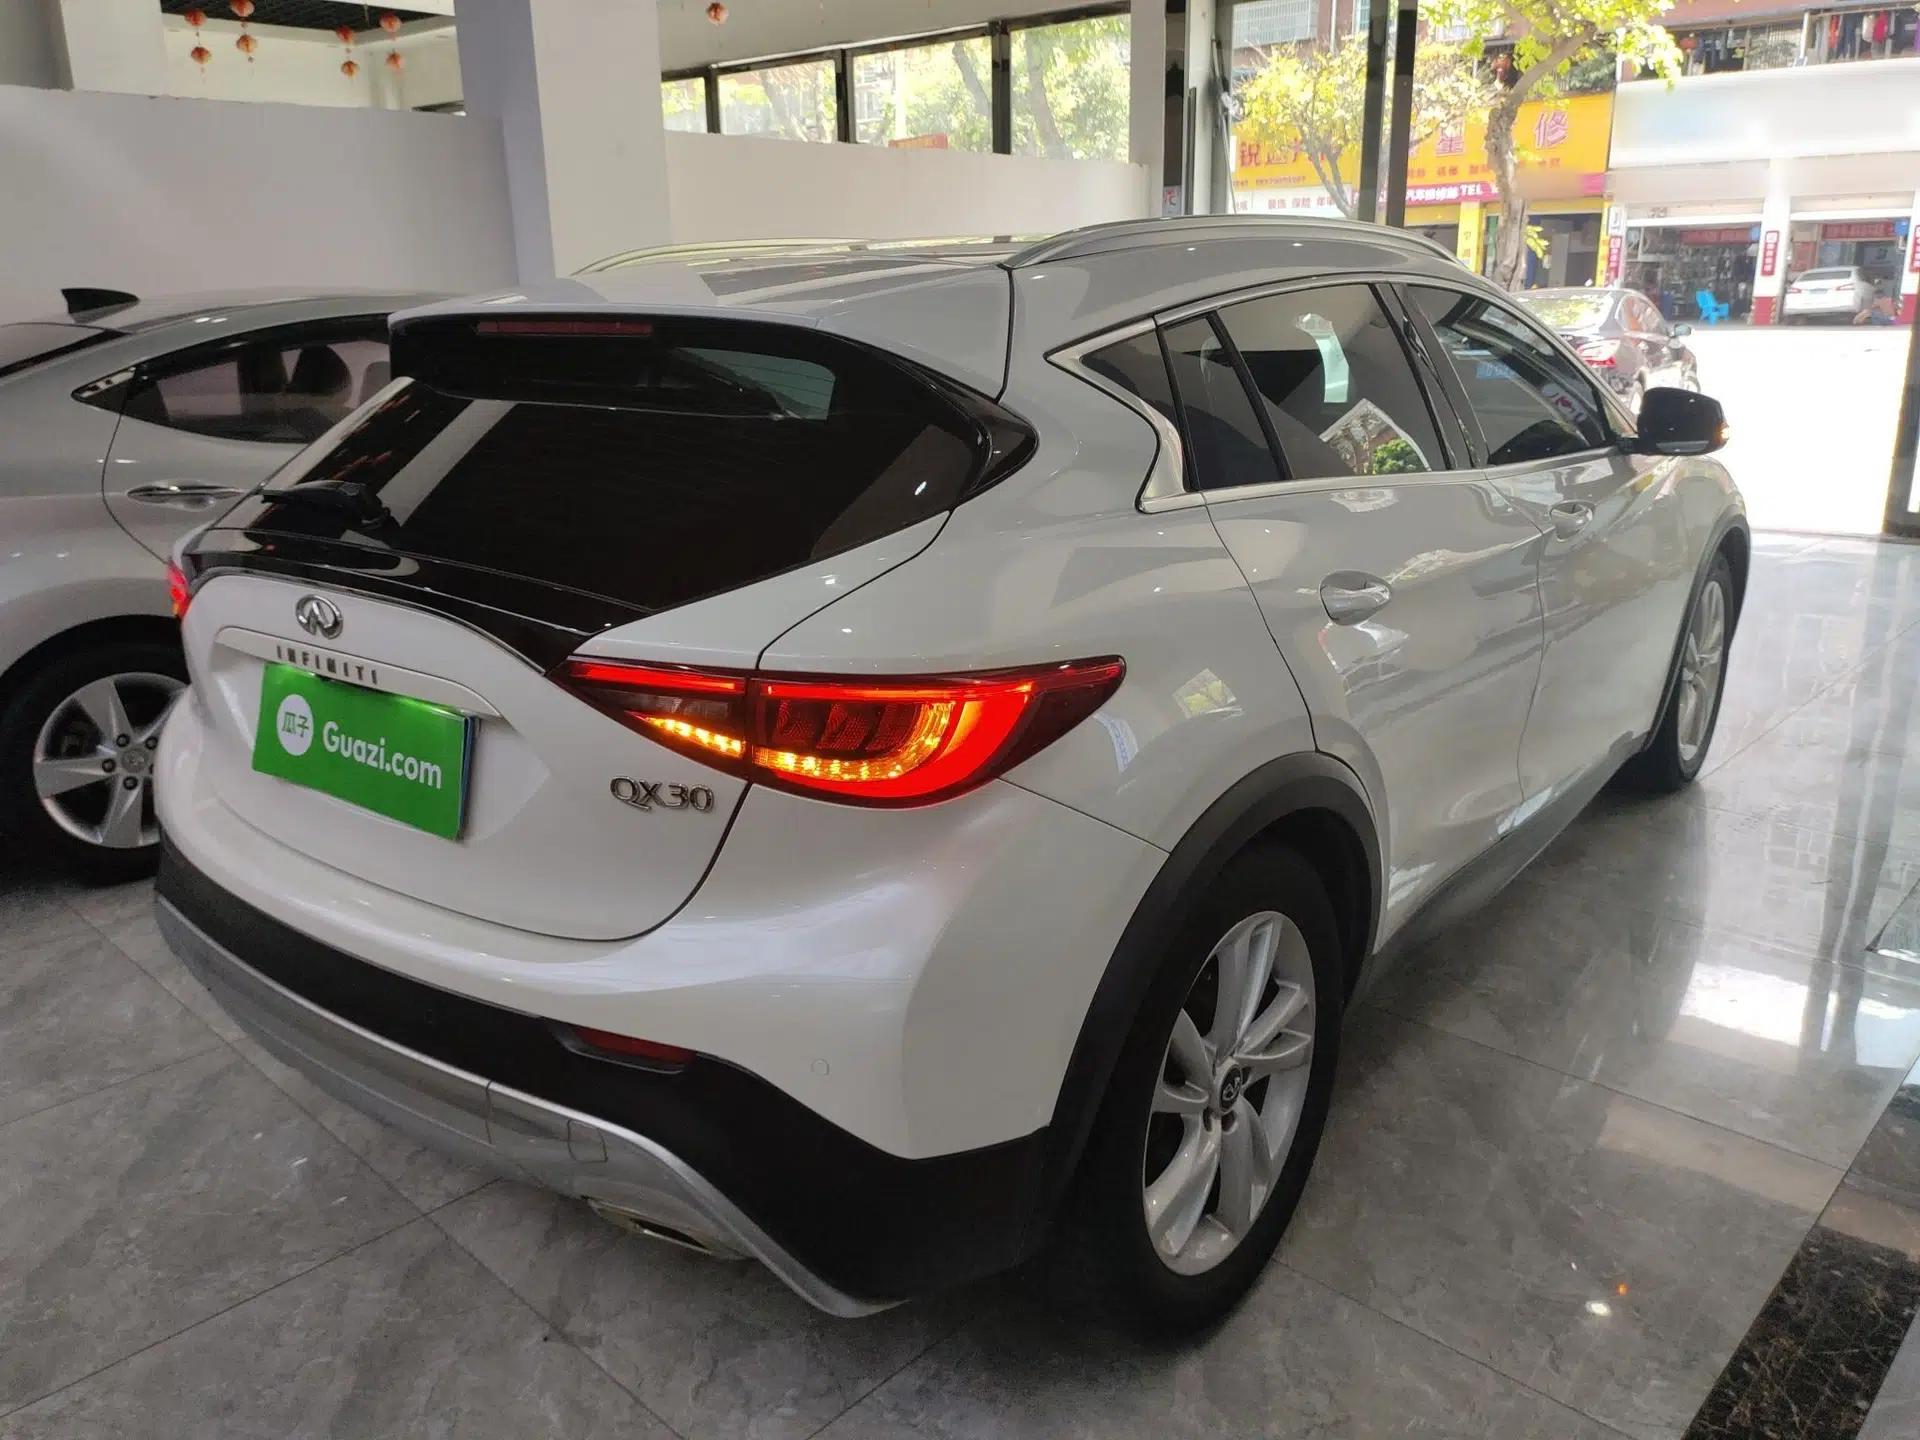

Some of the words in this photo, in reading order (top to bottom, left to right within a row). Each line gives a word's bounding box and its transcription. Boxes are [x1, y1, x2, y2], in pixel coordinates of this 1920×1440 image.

[1460, 183, 1483, 197] TEL
[276, 645, 378, 685] INFINITI
[282, 711, 310, 738] 瓜子
[323, 721, 442, 789] Guazi.com
[609, 776, 715, 812] QX30
